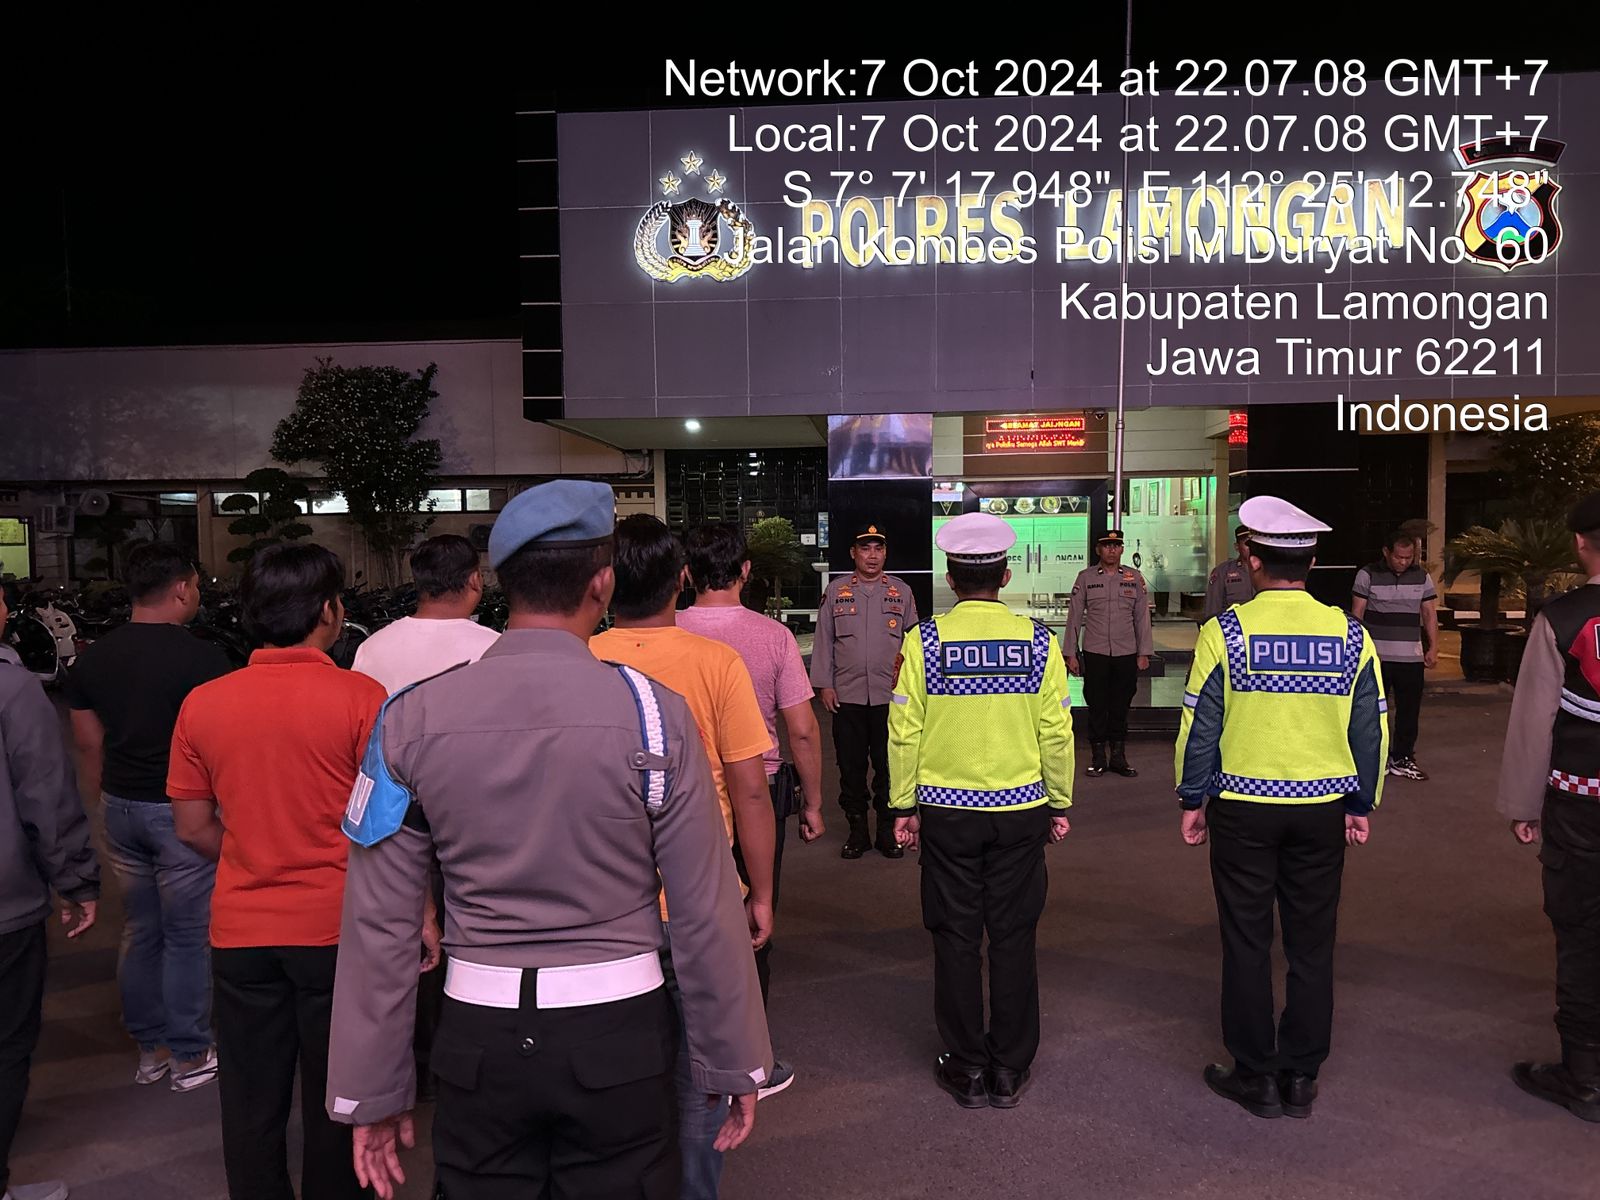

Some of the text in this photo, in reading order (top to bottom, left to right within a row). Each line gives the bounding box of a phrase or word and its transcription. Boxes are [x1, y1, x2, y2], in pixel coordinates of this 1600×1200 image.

[801, 178, 1406, 269] POLRES LAMONGAN
[945, 645, 1030, 668] POLISI
[1254, 641, 1341, 665] POLISI
